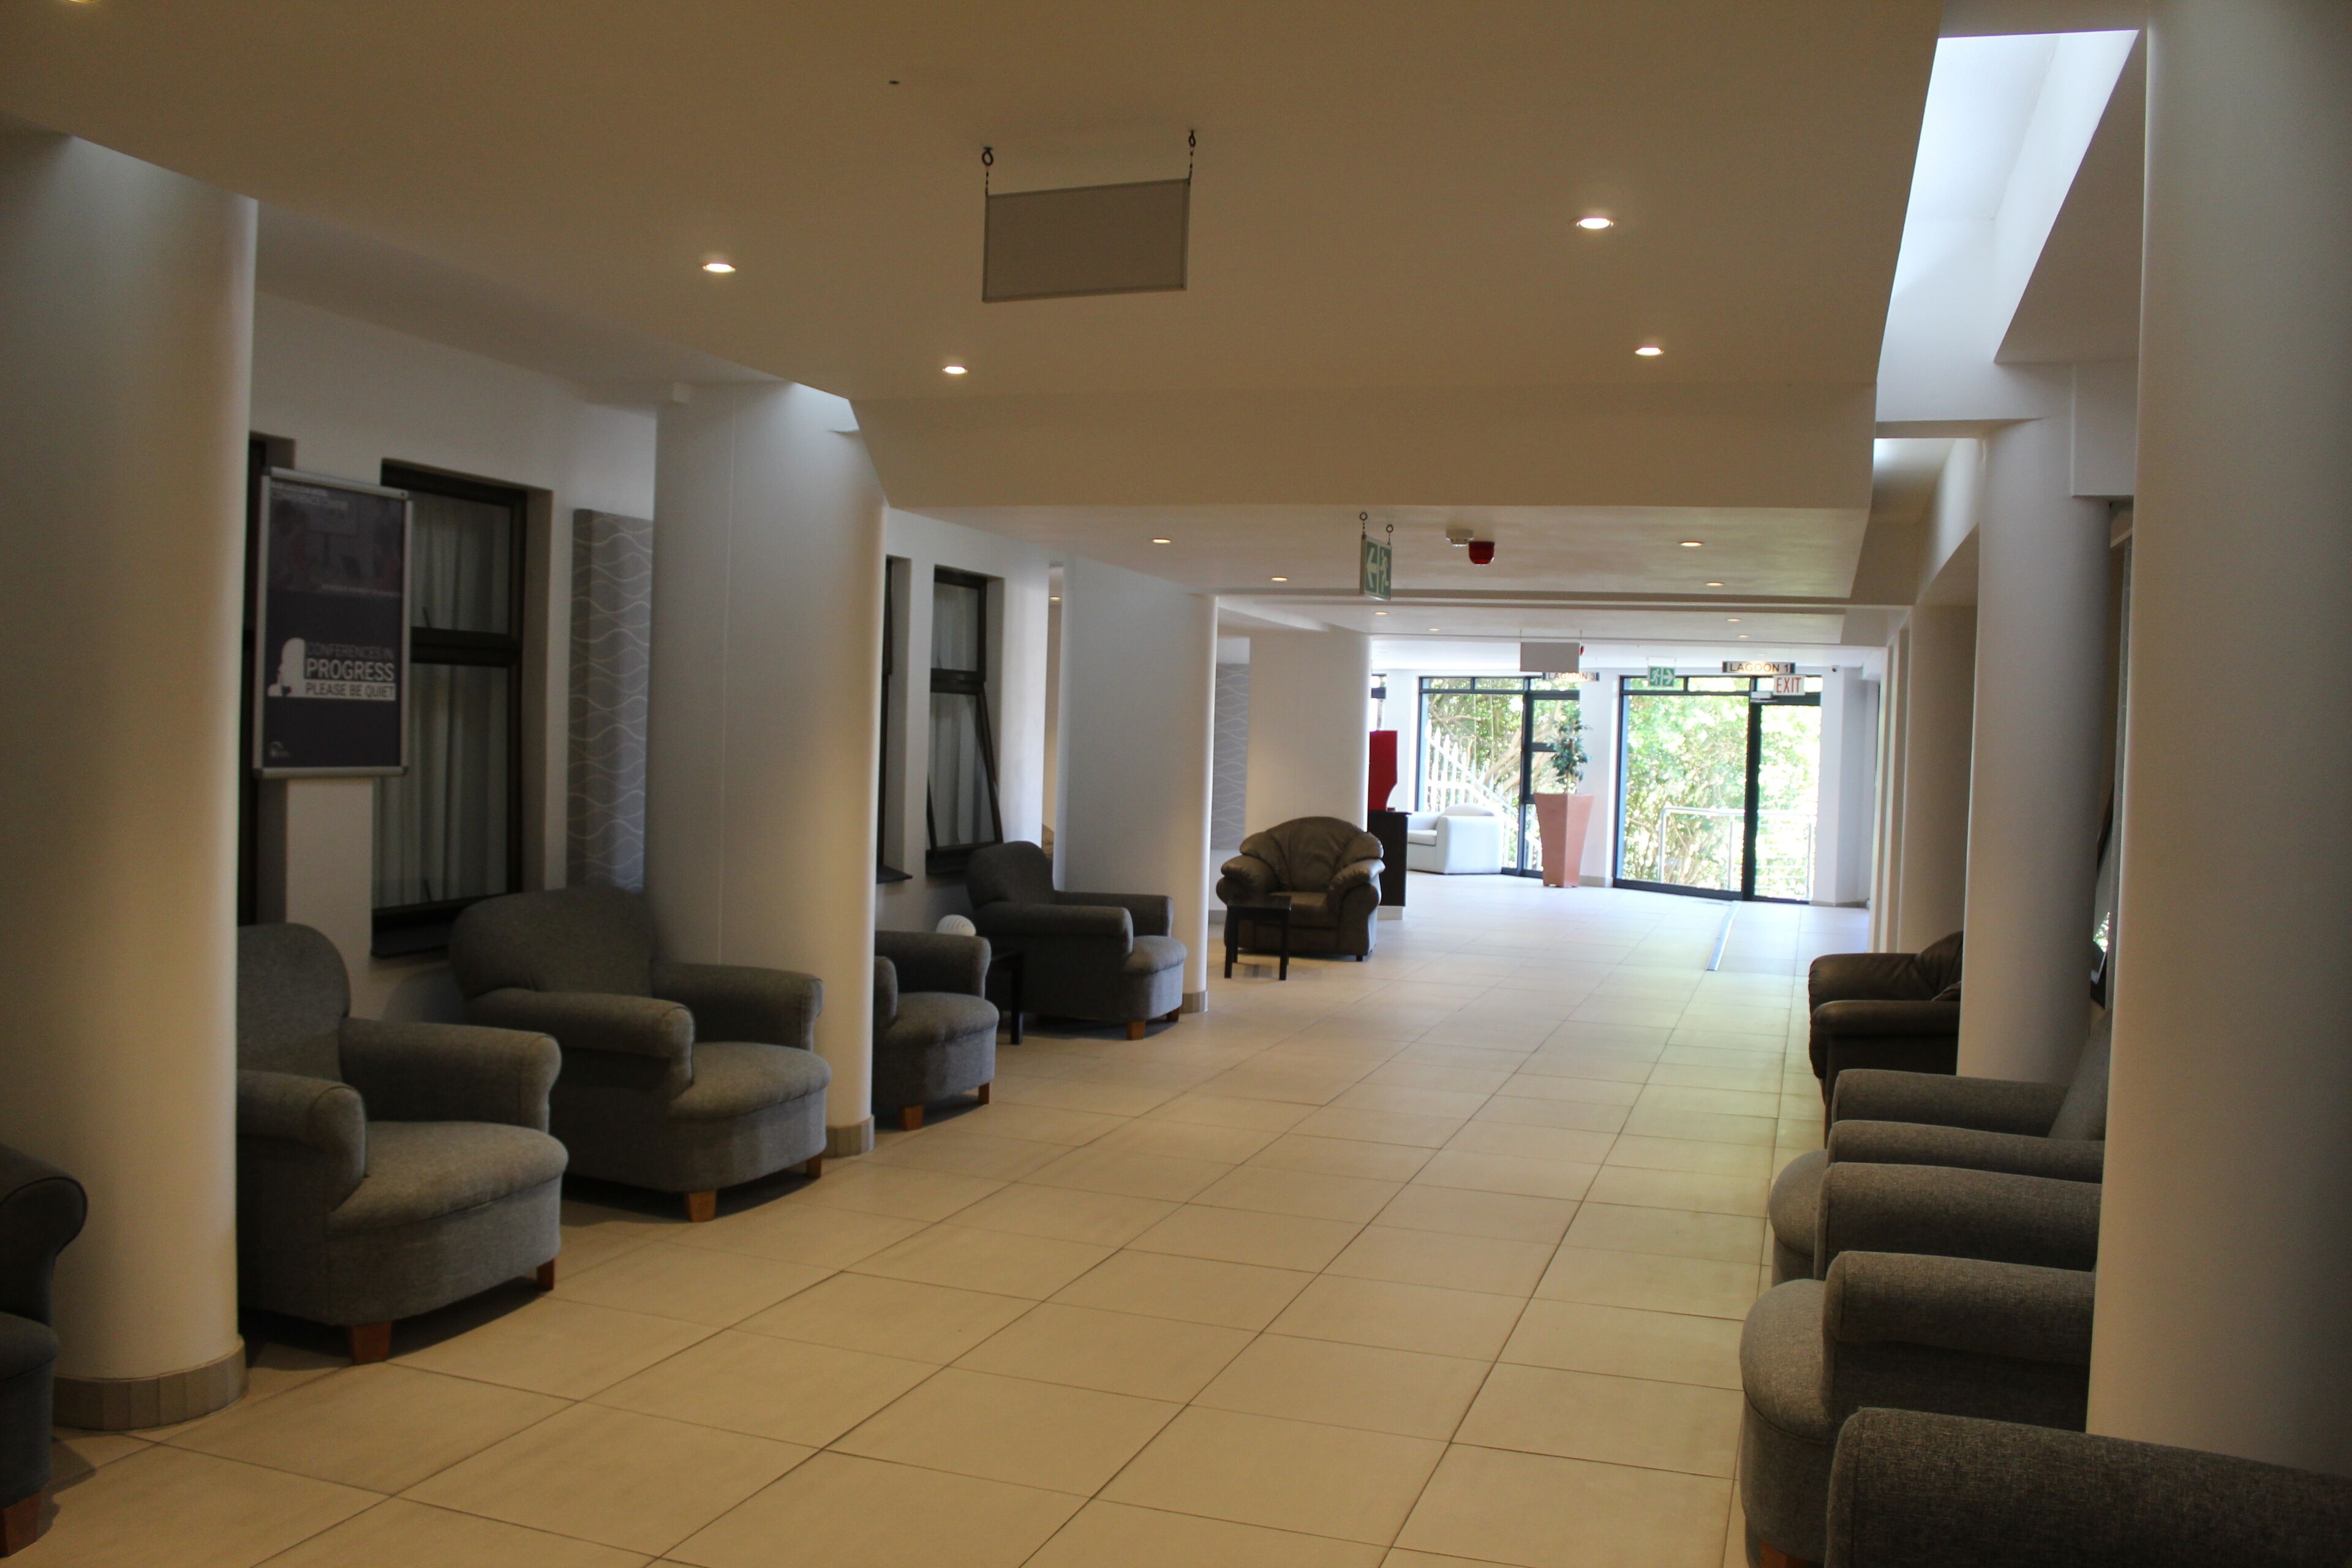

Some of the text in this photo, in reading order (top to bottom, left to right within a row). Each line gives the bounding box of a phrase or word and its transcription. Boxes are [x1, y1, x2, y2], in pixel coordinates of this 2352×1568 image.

[307, 641, 381, 659] CONFERENCES
[306, 658, 394, 681] PROGRESS
[1730, 662, 1789, 673] LAGOON 1
[306, 682, 393, 698] PLEASE BE QUIET
[1776, 676, 1801, 693] EXIT
